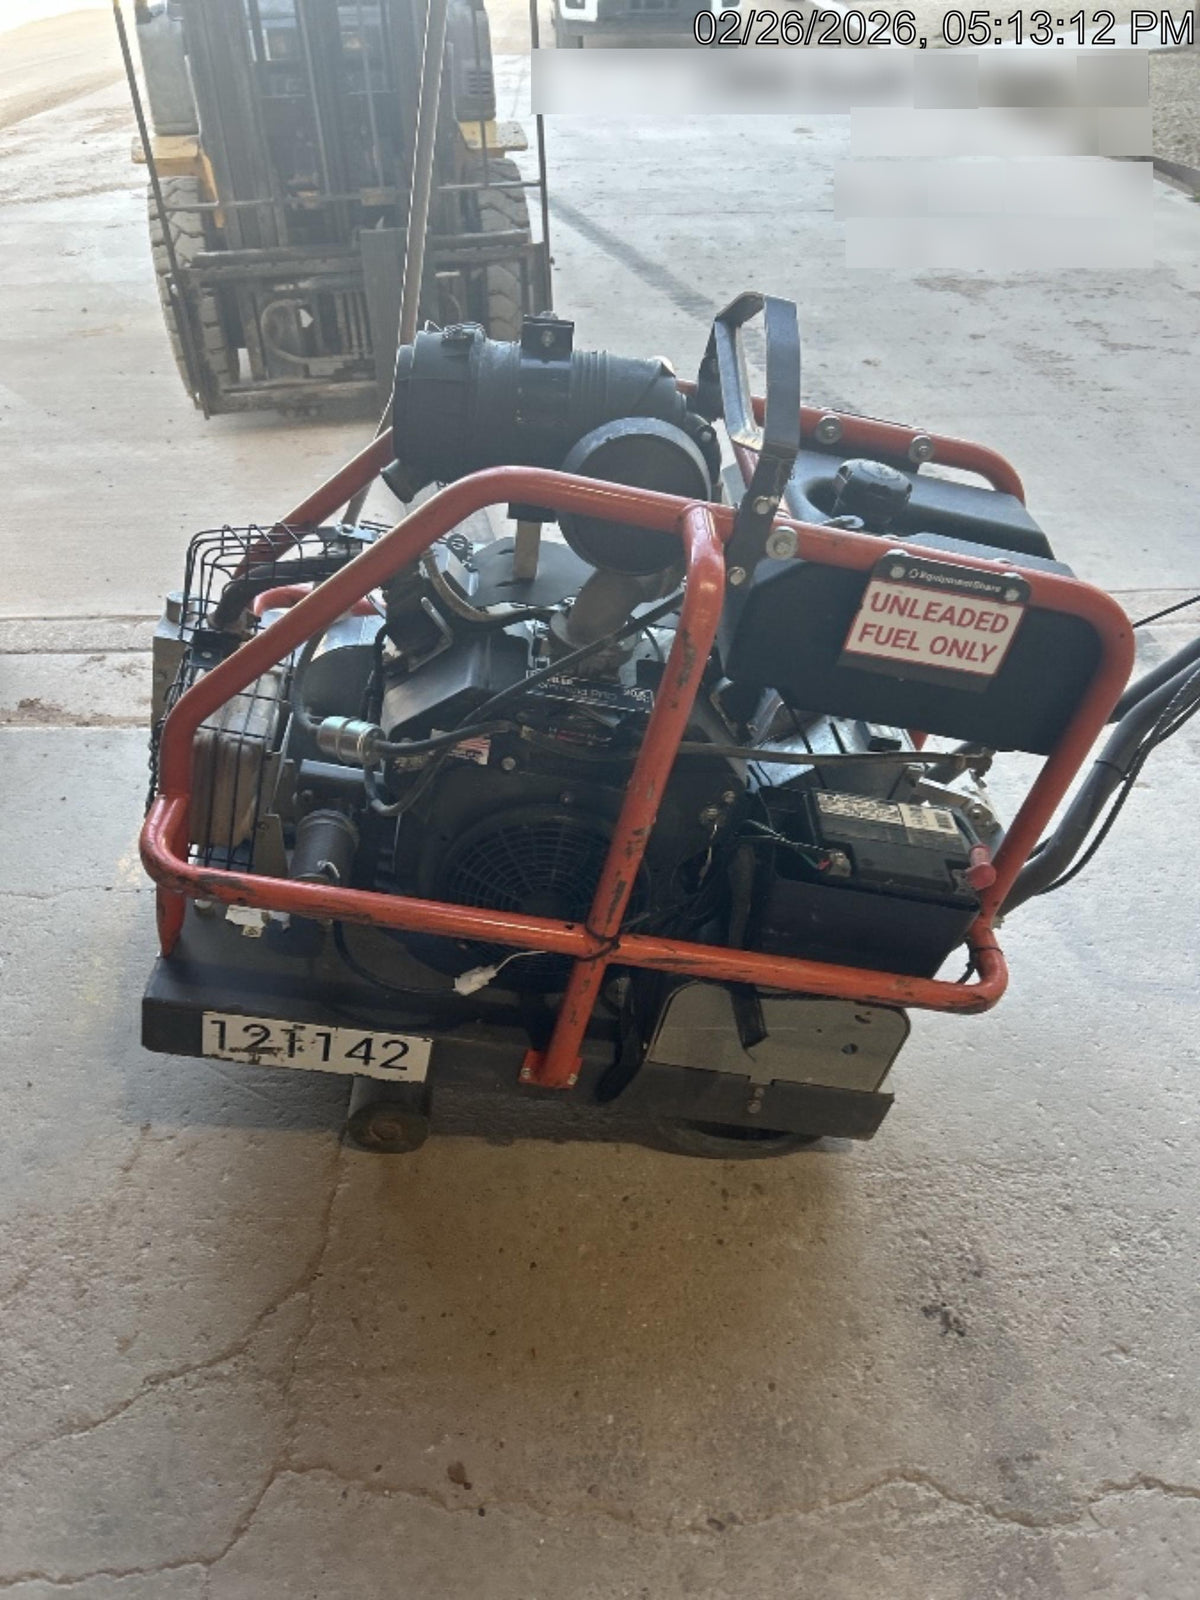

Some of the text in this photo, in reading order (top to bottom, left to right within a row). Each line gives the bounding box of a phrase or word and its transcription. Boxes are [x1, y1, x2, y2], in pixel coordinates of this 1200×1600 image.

[870, 591, 1009, 634] UNLEADED
[858, 622, 998, 663] FUEL ONLY
